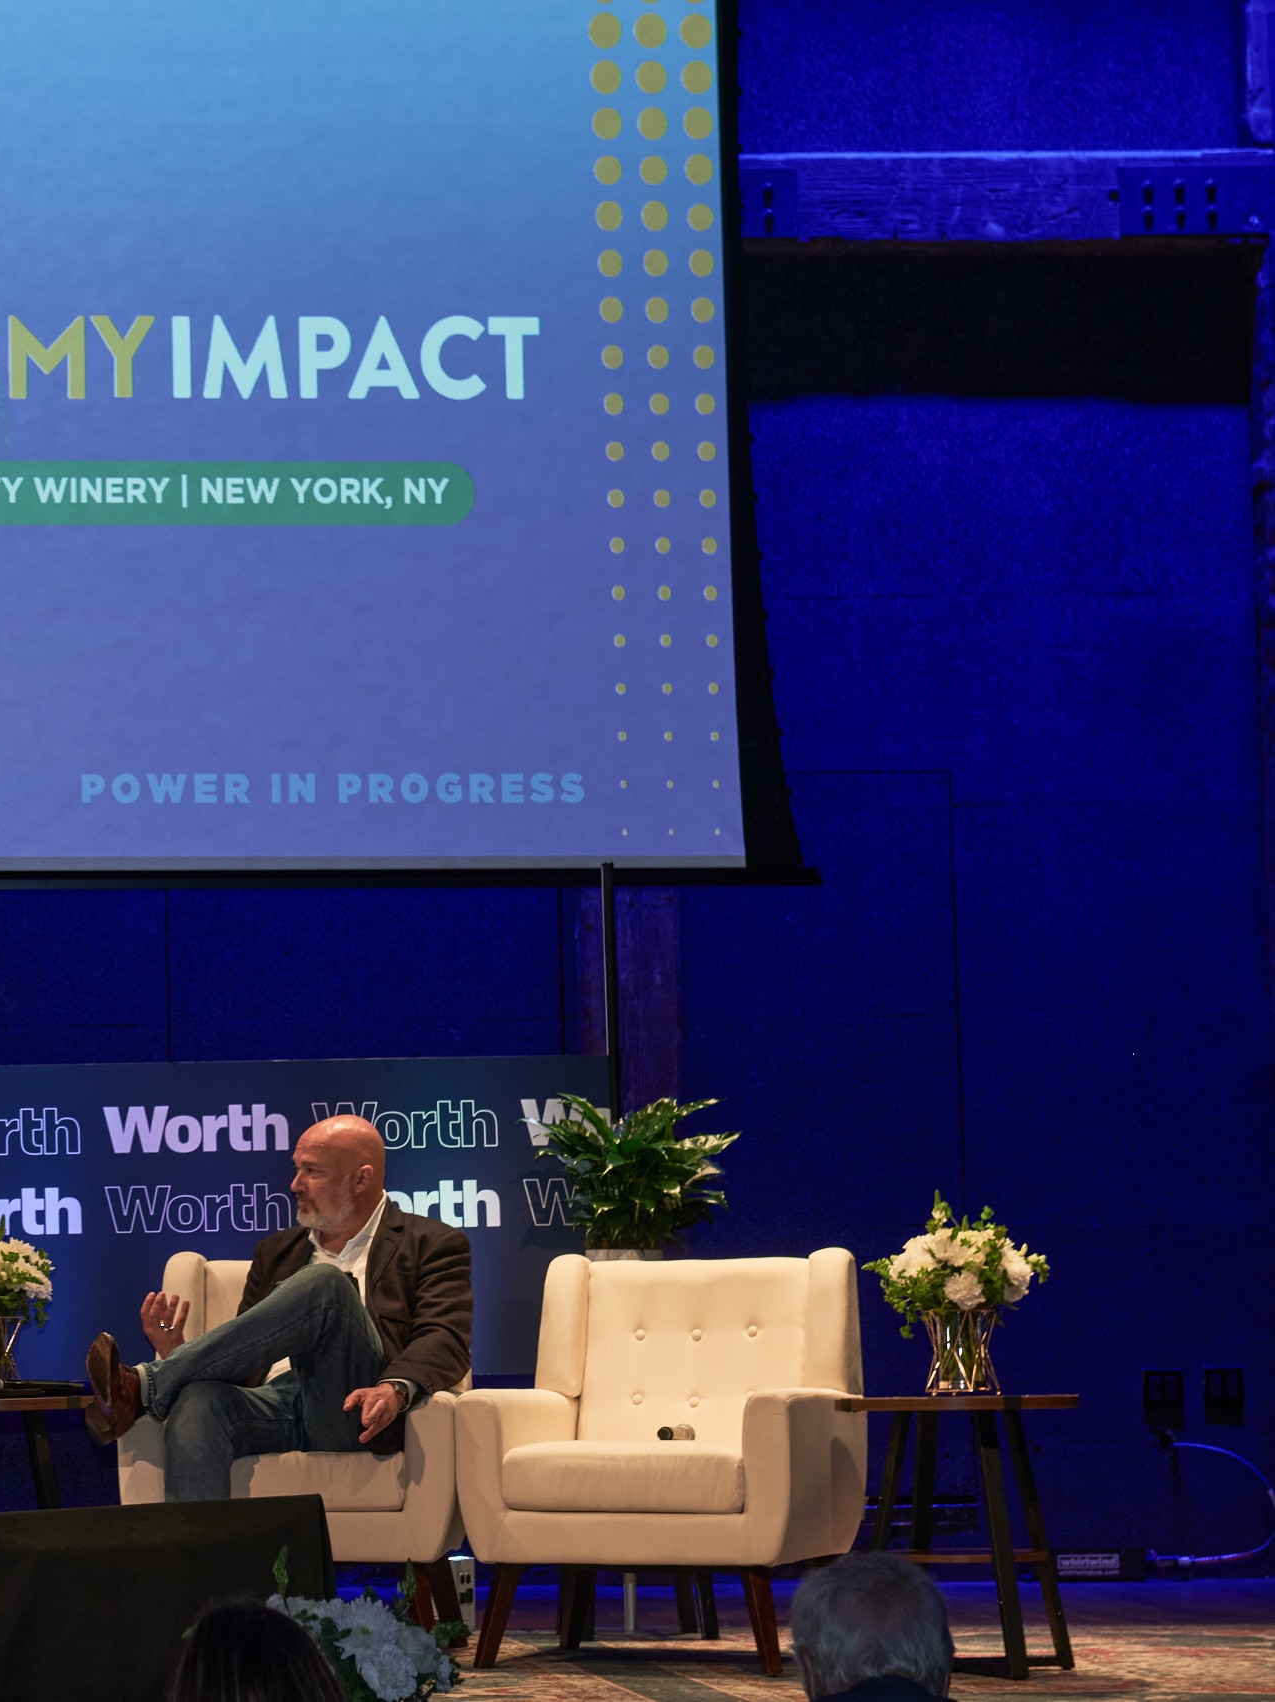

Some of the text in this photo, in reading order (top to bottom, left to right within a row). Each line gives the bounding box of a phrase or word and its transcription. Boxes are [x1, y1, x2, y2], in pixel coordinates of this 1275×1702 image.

[172, 315, 540, 400] IMPACT
[33, 477, 170, 504] WINERY
[200, 478, 279, 505] NEW
[290, 478, 393, 510] YORK,
[404, 479, 449, 505] NY
[81, 772, 586, 803] POWER IN PROGRESS
[103, 1104, 290, 1153] Worth
[104, 1183, 292, 1234] Worth
